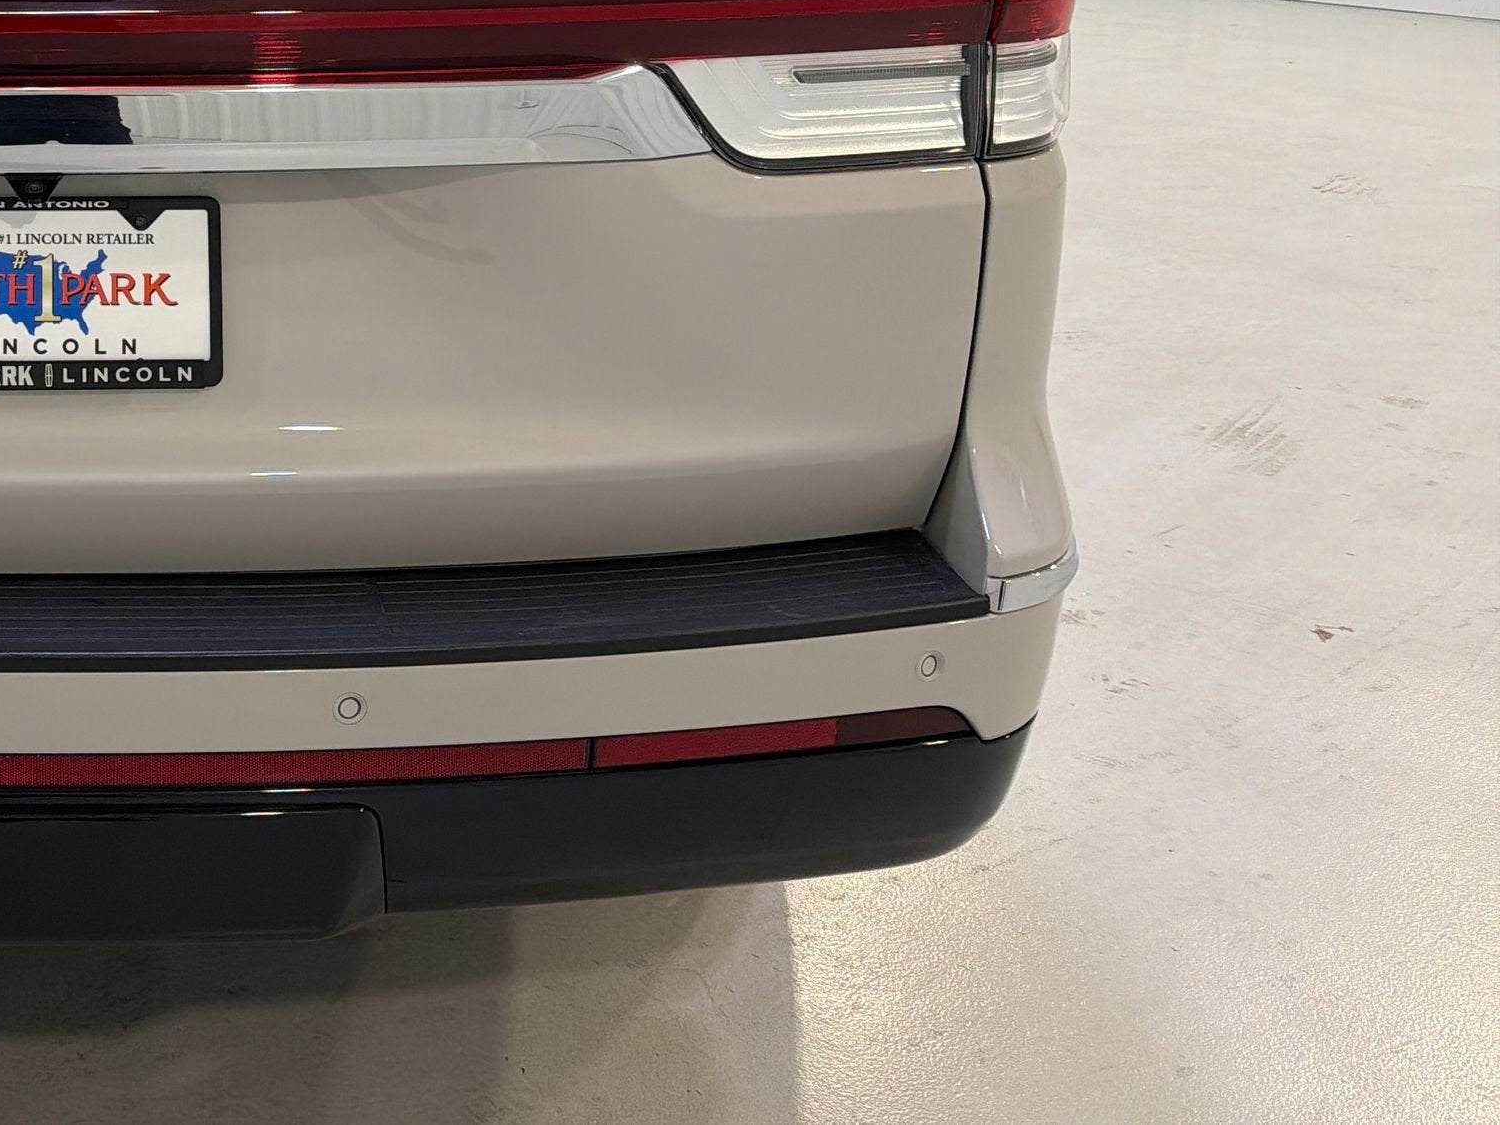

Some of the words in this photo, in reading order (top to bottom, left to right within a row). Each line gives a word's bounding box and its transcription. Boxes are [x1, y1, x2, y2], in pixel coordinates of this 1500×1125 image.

[16, 233, 82, 245] LINCOLN
[86, 233, 155, 245] RETAILER
[60, 273, 179, 307] PARK
[62, 366, 193, 385] LINCOLN
